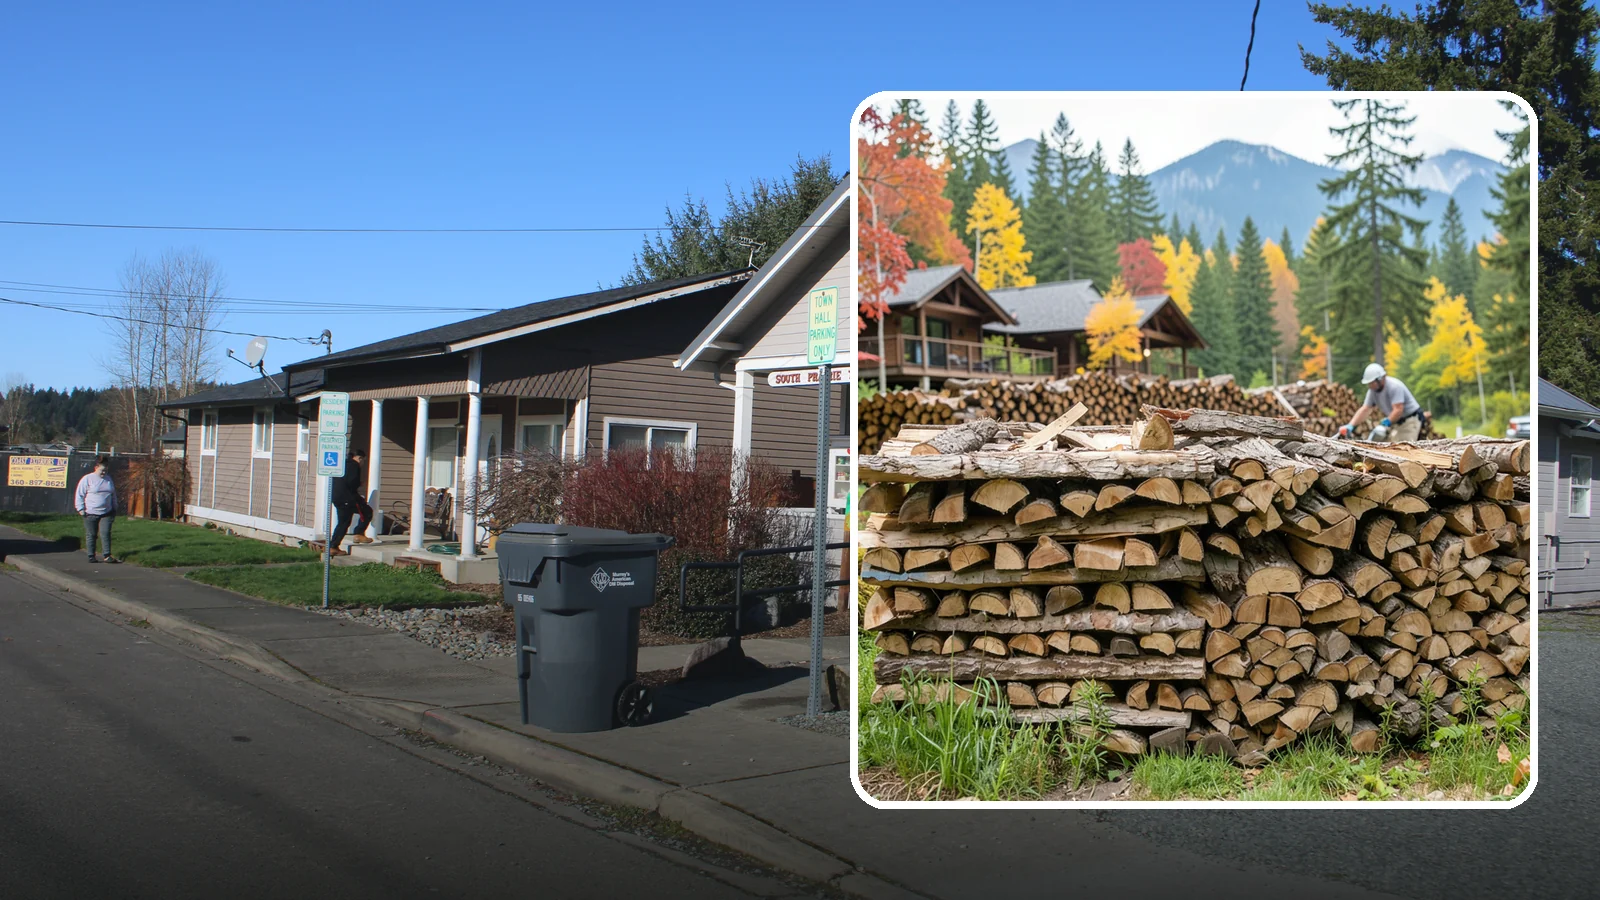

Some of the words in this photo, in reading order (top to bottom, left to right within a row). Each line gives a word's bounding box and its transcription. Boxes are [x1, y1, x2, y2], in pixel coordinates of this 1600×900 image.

[815, 295, 833, 308] TOWN
[814, 312, 831, 324] HALL
[810, 327, 835, 340] PARKING
[814, 345, 831, 357] ONLY
[776, 374, 801, 384] SOUTH
